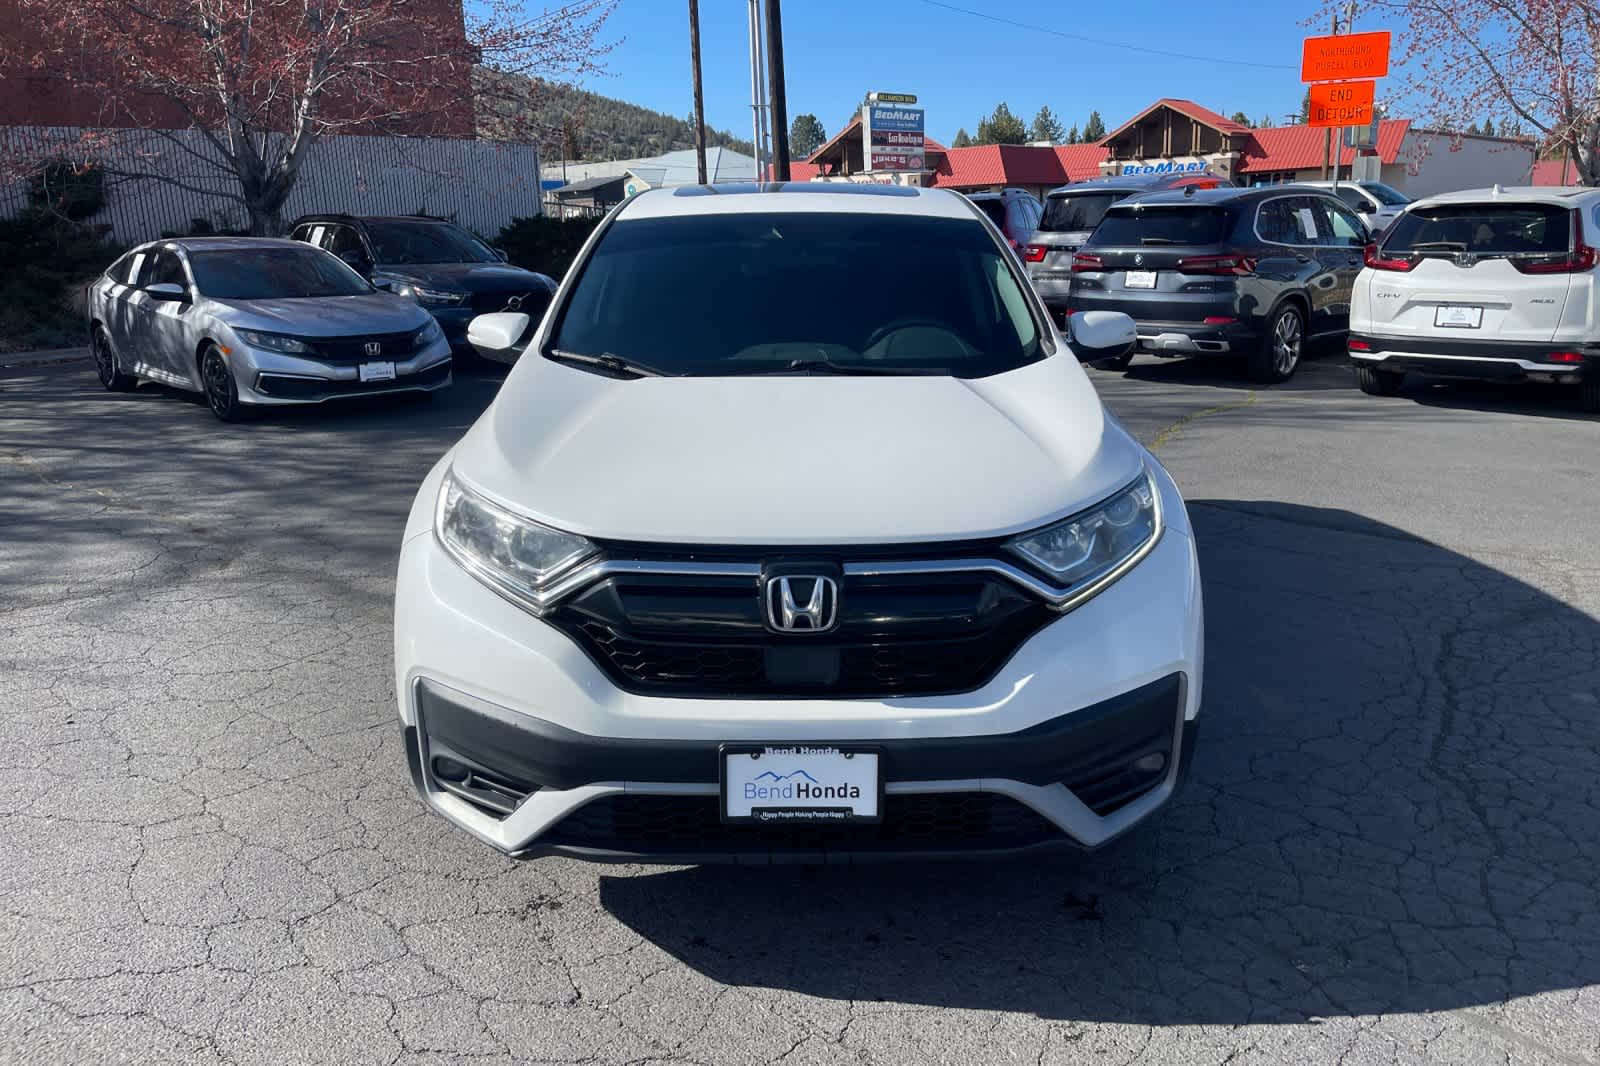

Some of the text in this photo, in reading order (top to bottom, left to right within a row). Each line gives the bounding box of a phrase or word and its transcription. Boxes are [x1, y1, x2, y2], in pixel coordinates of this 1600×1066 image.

[1330, 89, 1353, 102] END
[1317, 106, 1364, 121] DETOUR
[800, 746, 840, 755] Honda
[744, 782, 861, 799] Bend Honda
